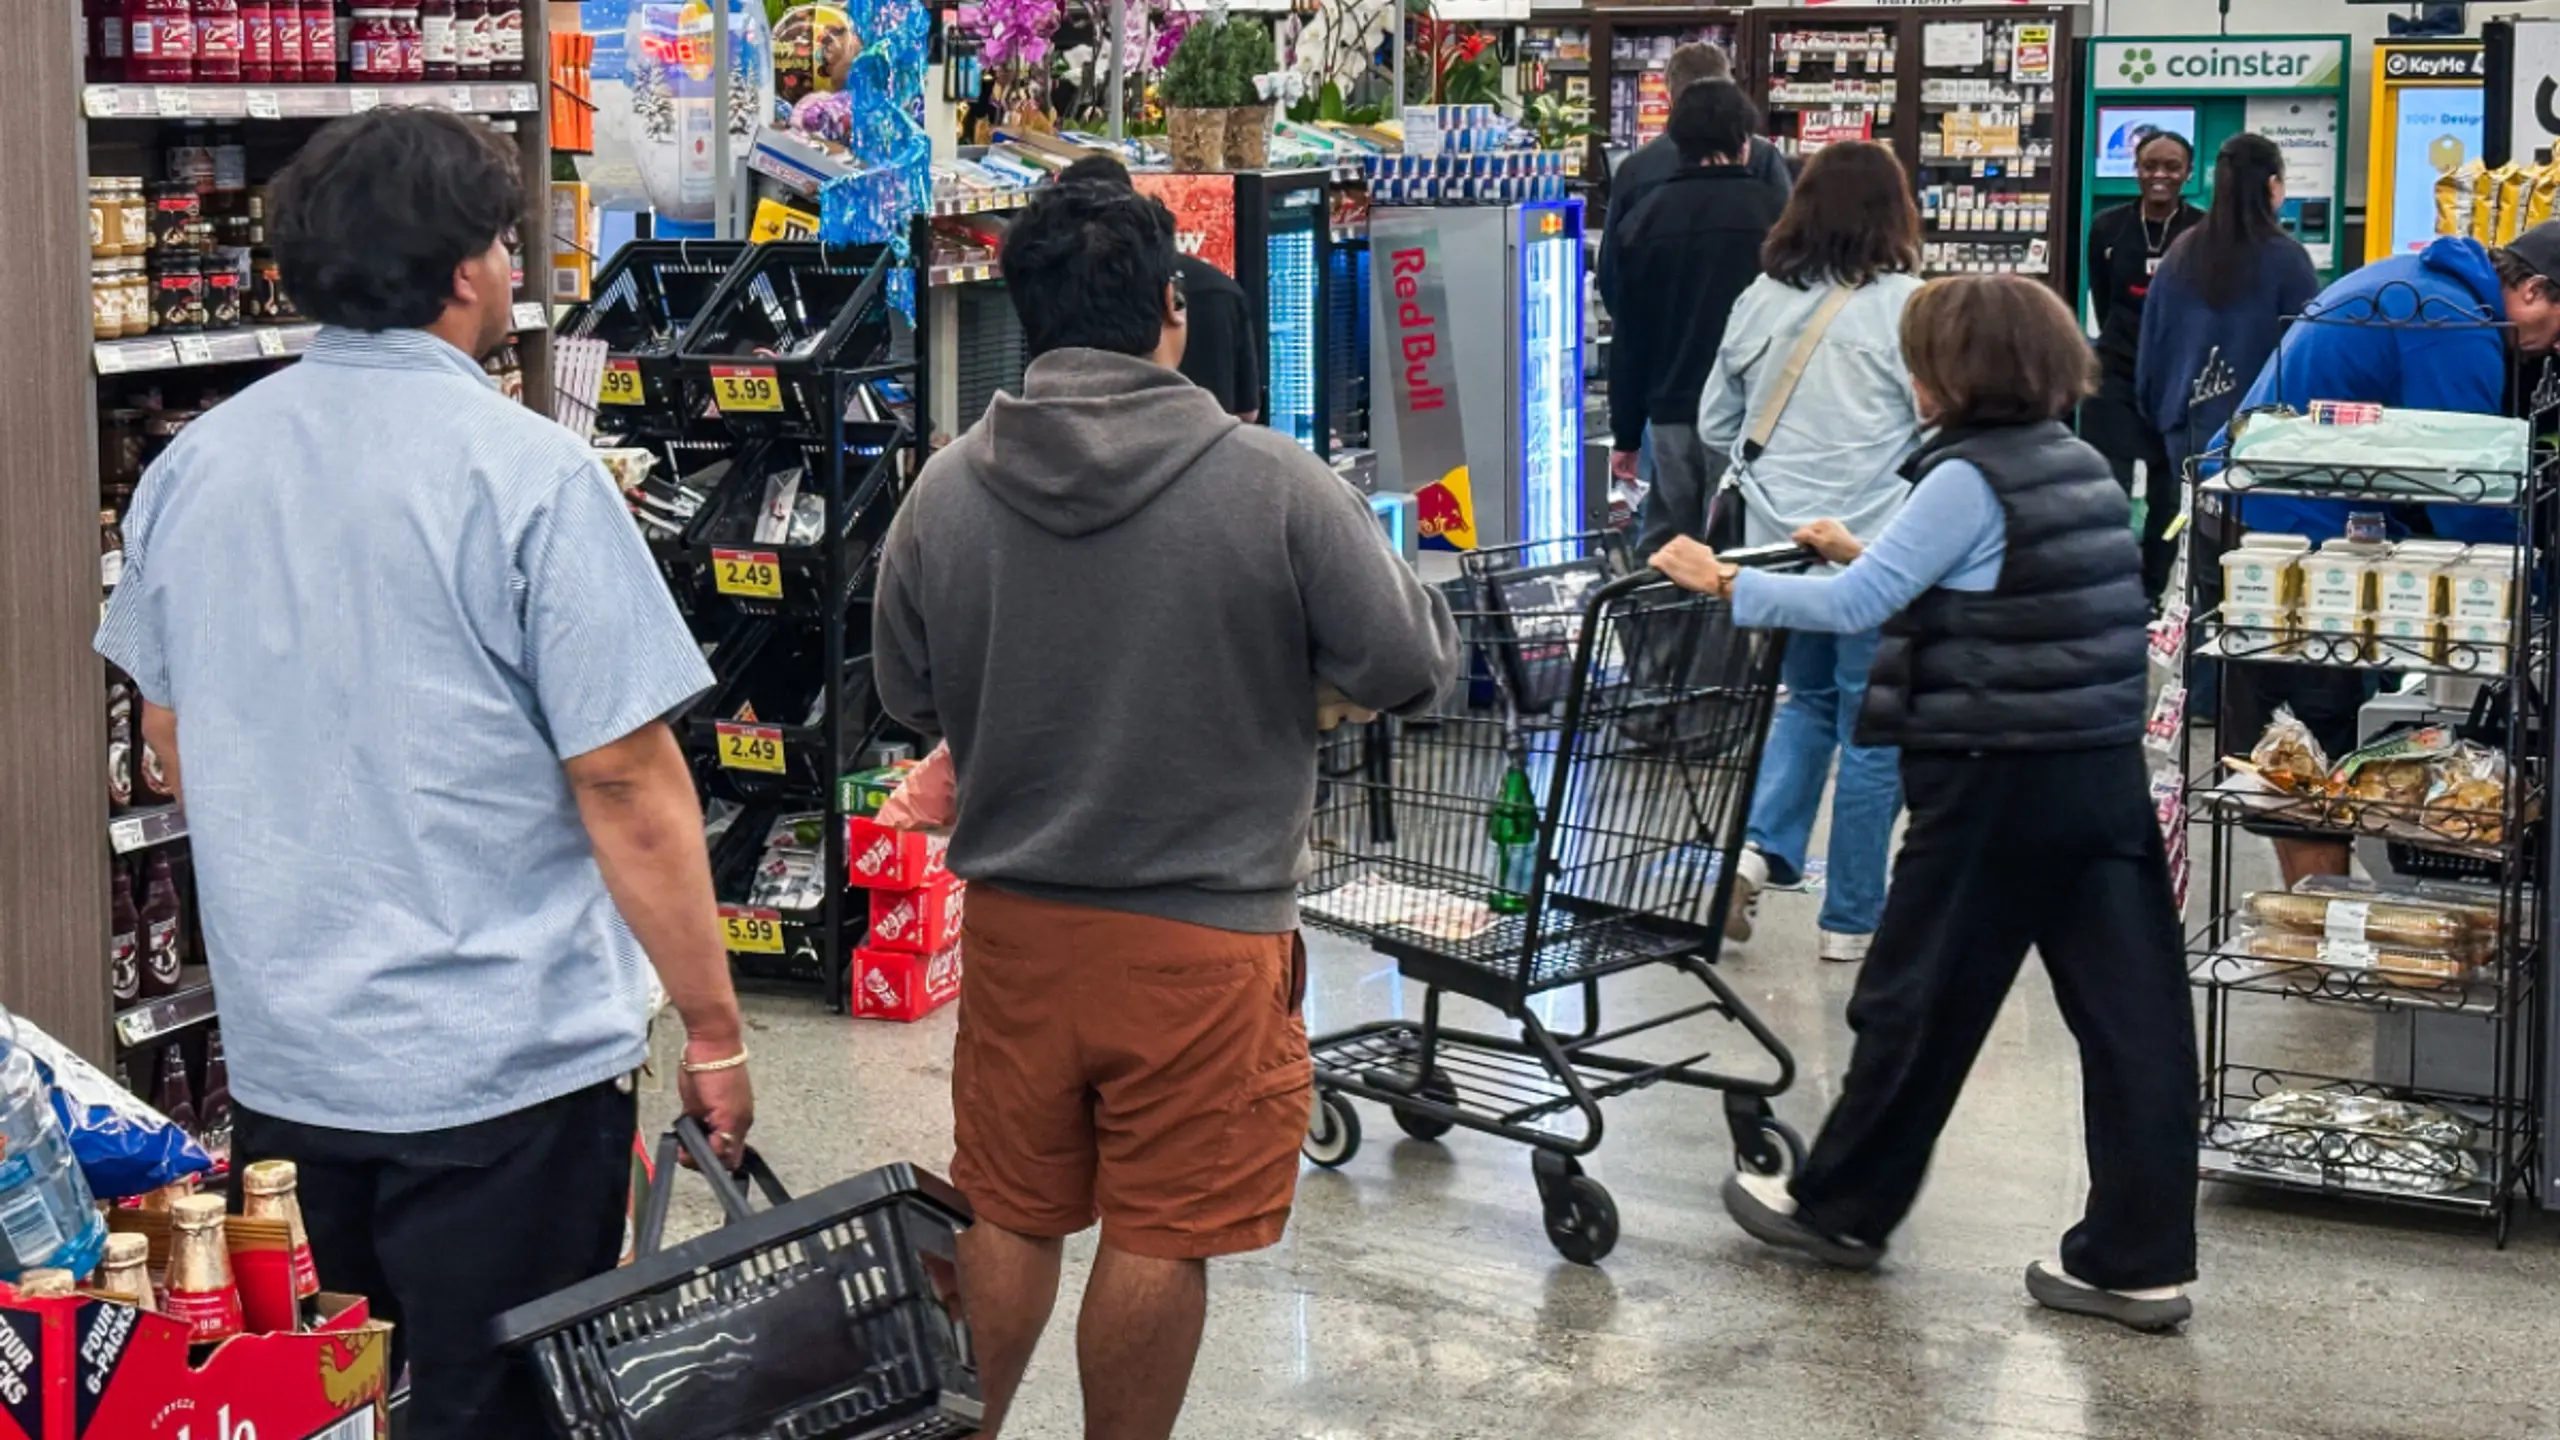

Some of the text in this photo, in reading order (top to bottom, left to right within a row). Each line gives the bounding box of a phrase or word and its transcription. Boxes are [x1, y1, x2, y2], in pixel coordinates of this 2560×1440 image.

[2166, 47, 2311, 78] coinstar
[2408, 56, 2466, 76] KeyMe
[1390, 247, 1446, 412] Red Bull
[603, 372, 634, 392] .99
[723, 378, 771, 400] 3.99
[726, 561, 773, 586] 2.49
[730, 735, 776, 761] 2.49
[727, 918, 773, 942] 5.99
[81, 1303, 116, 1363] FOUR
[86, 1307, 136, 1395] 6-PACKS
